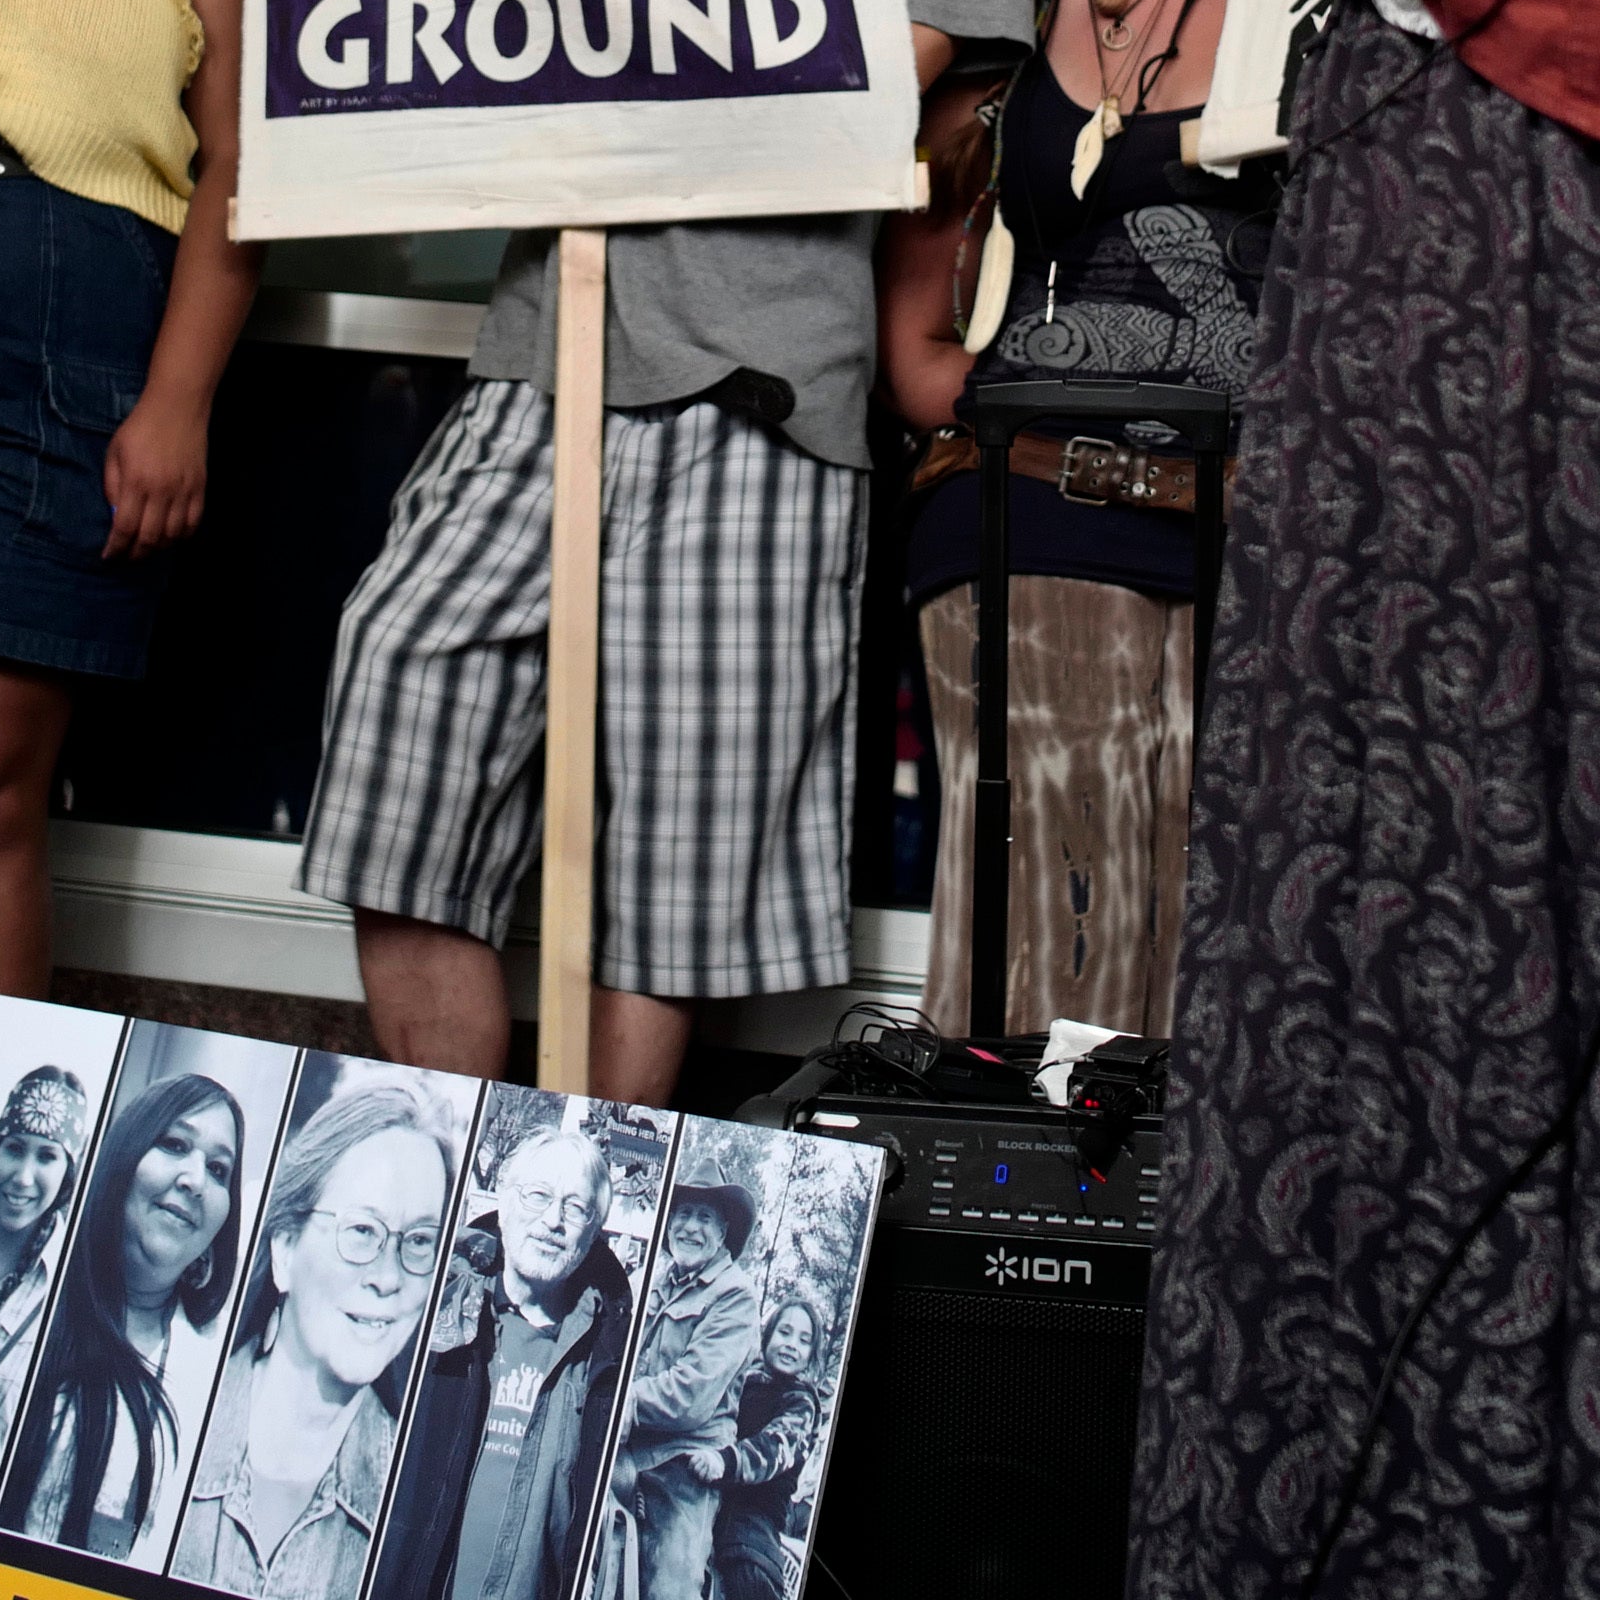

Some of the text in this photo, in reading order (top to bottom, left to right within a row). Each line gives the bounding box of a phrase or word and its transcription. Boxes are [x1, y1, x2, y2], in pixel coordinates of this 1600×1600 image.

[638, 1128, 655, 1141] HER
[997, 1140, 1078, 1154] BLOCK ROCKER
